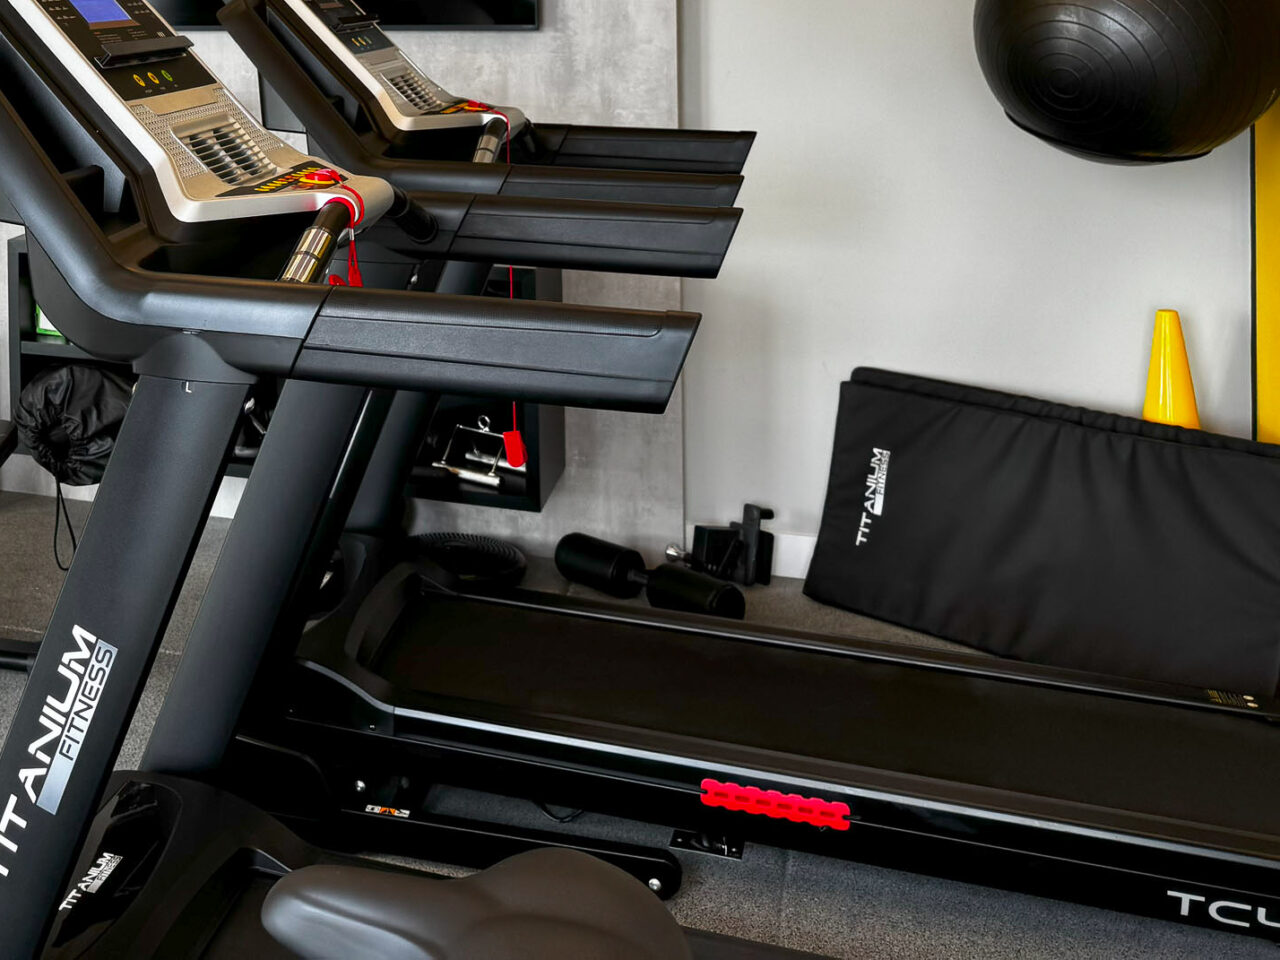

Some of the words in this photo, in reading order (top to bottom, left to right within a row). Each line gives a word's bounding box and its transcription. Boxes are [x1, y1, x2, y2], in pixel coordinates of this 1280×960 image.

[855, 447, 883, 546] TITANIUM
[58, 644, 114, 762] FITNESS
[58, 852, 114, 911] TITANIUM
